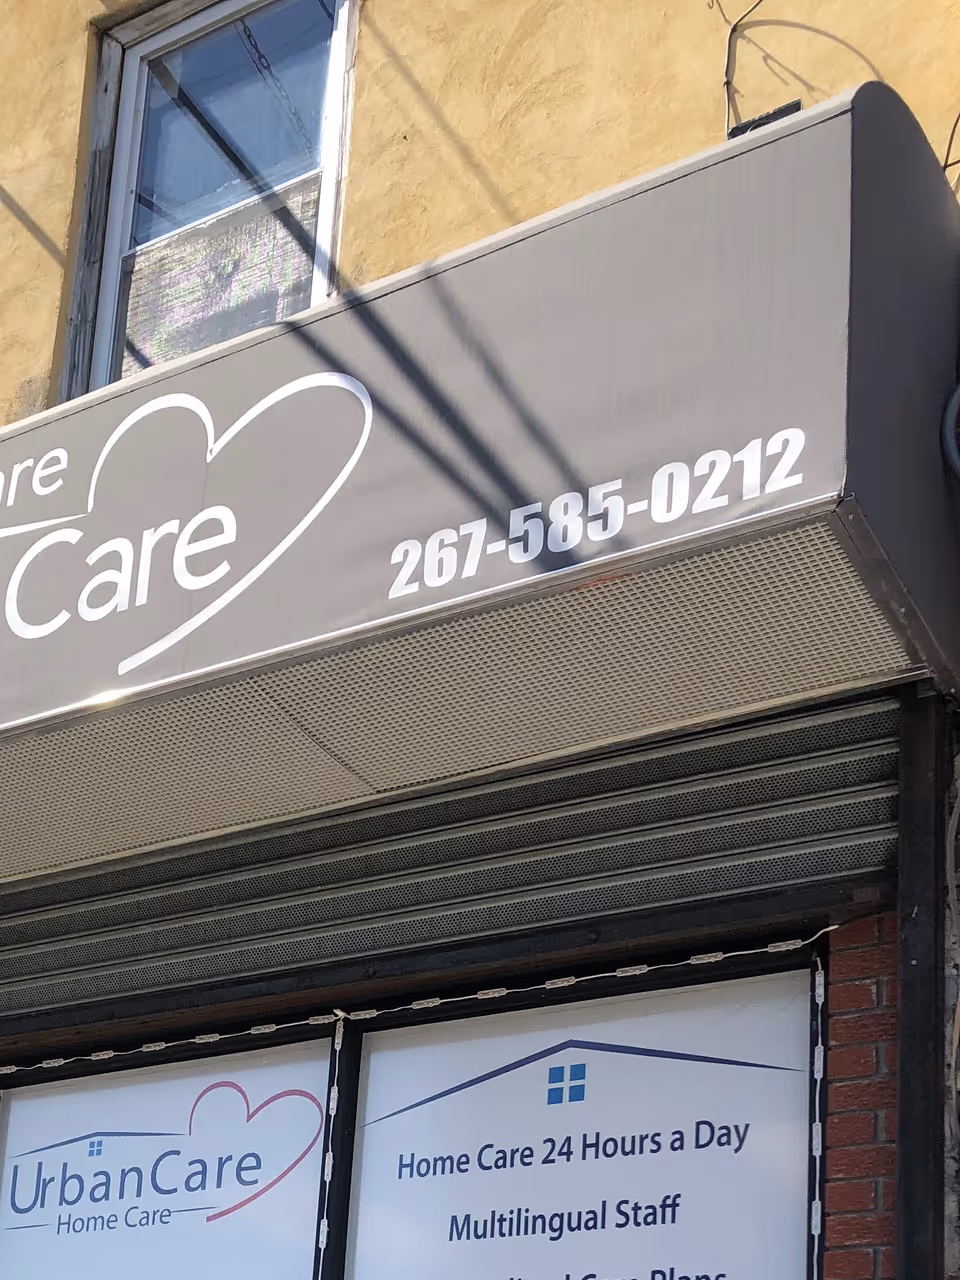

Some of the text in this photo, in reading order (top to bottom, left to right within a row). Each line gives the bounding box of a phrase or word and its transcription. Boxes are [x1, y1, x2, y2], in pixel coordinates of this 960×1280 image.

[388, 428, 806, 600] 267-585-0212
[5, 505, 236, 639] Care
[397, 1119, 750, 1179] Home Care 24 Hours a Day
[10, 1150, 262, 1214] UrbanCare
[57, 1206, 172, 1235] Home Care
[448, 1193, 681, 1241] Multilingual Staff
